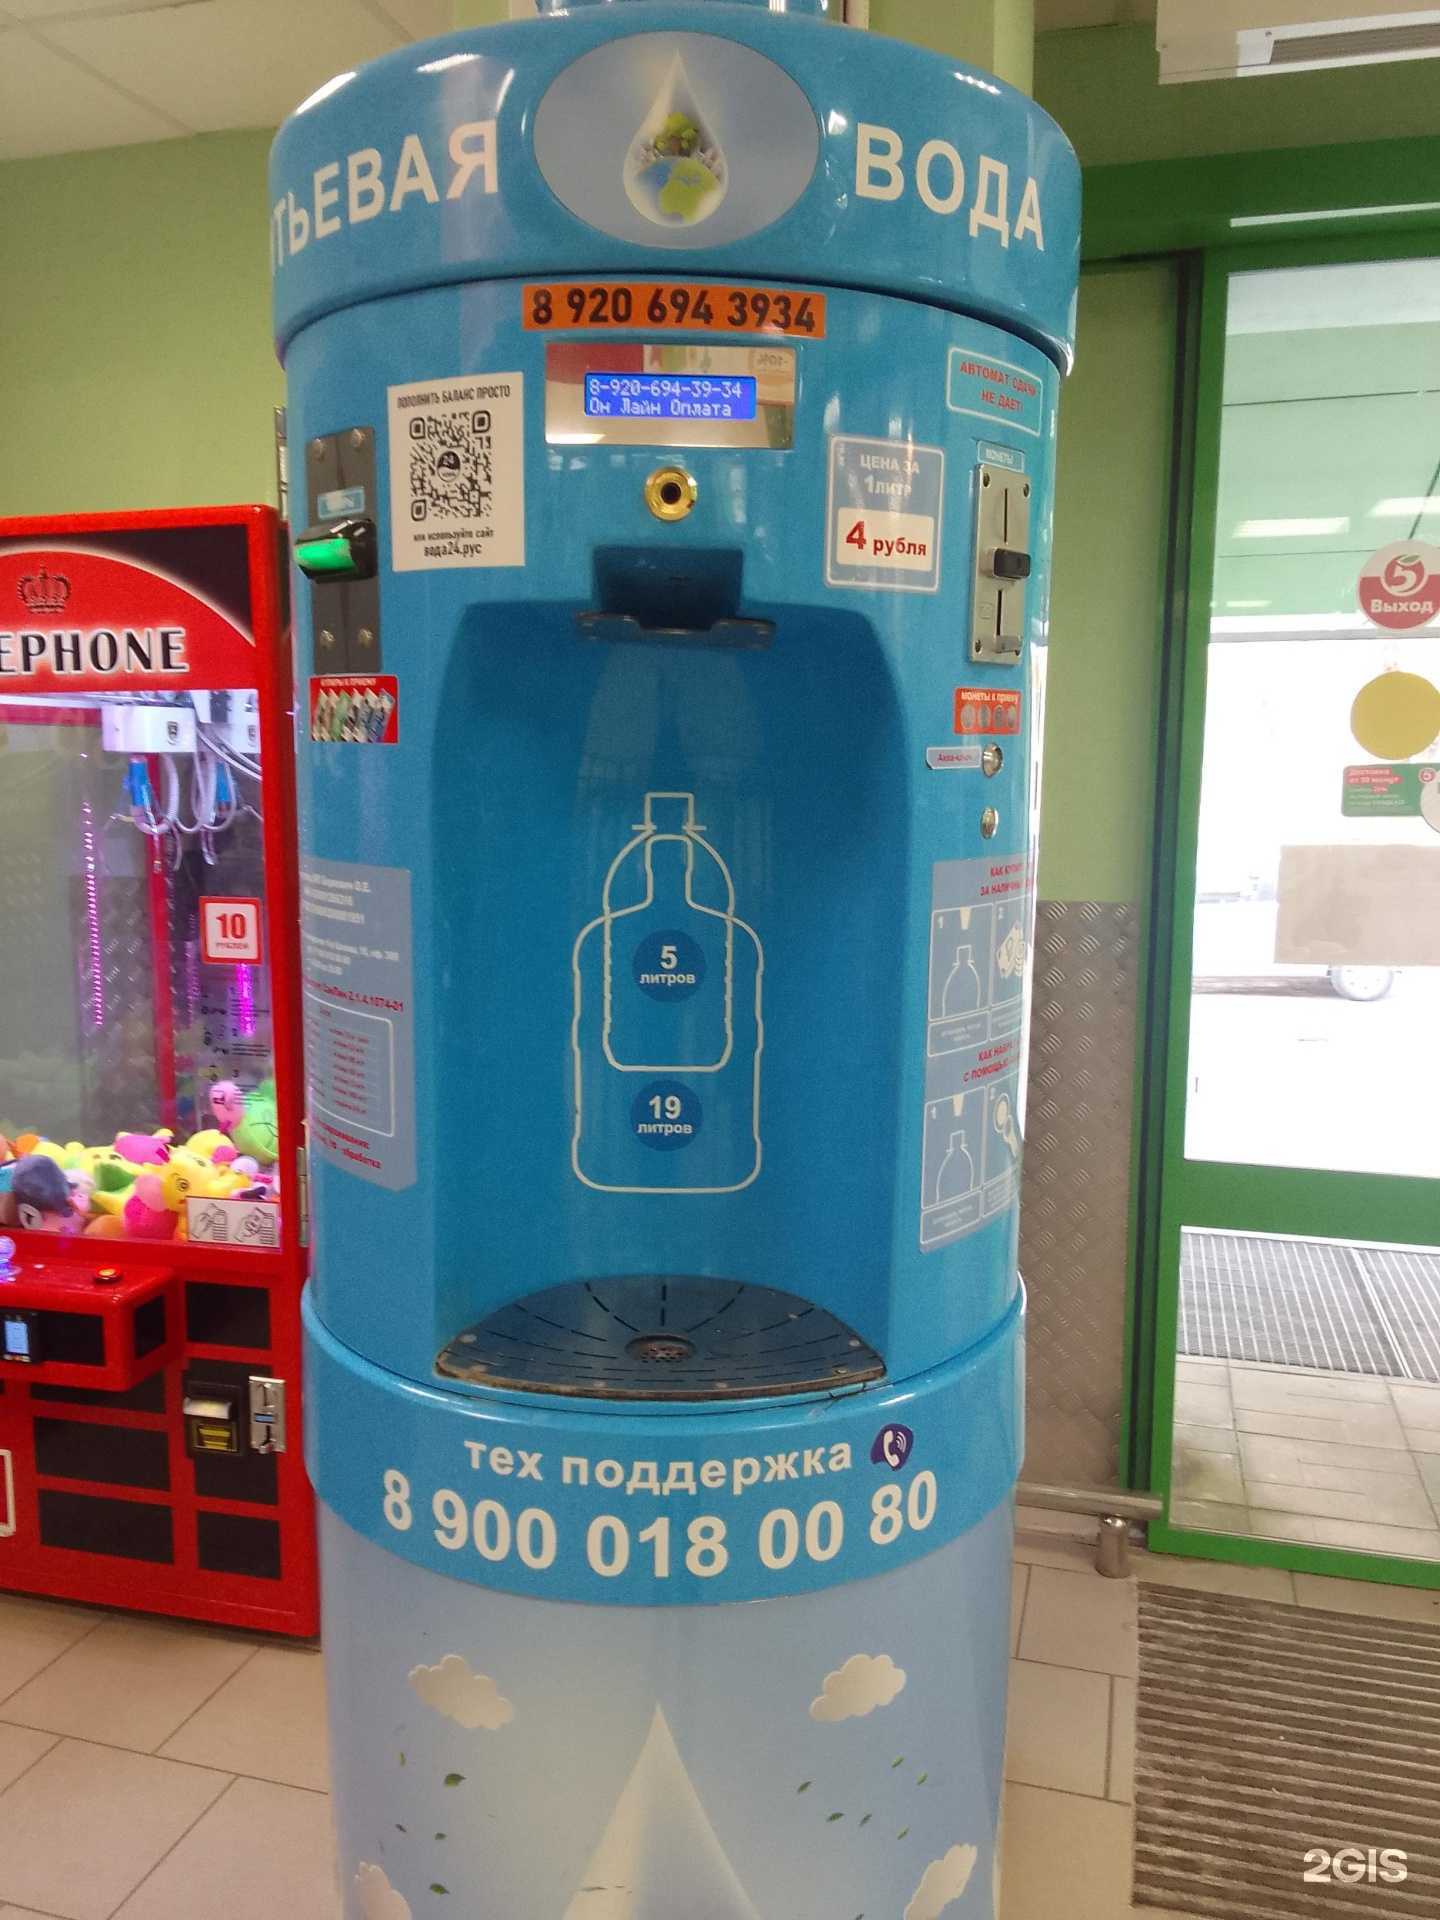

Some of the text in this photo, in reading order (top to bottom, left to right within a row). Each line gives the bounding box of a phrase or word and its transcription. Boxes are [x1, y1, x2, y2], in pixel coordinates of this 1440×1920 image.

[856, 122, 1044, 251] ВОДА
[532, 287, 815, 332] 8 920 694 3934
[960, 361, 1009, 385] АВТОМАТ
[442, 388, 475, 402] БАЛАНС
[477, 384, 510, 400] ПРОСТО
[588, 378, 743, 399] 8-920-694-39-34
[589, 399, 732, 417] Он Лайн Оплата
[860, 454, 920, 474] ЦЕНА ЗА
[475, 527, 494, 539] сайт
[846, 520, 927, 556] 4 рубля
[1370, 599, 1434, 615] Выход
[216, 913, 247, 938] 10
[938, 916, 944, 929] 1
[660, 945, 678, 970] 5
[639, 972, 696, 985] литров
[649, 1095, 682, 1120] 19
[637, 1123, 693, 1136] литров
[464, 1440, 852, 1495] тех поддержка
[383, 1469, 937, 1578] 8 900 018 00 80
